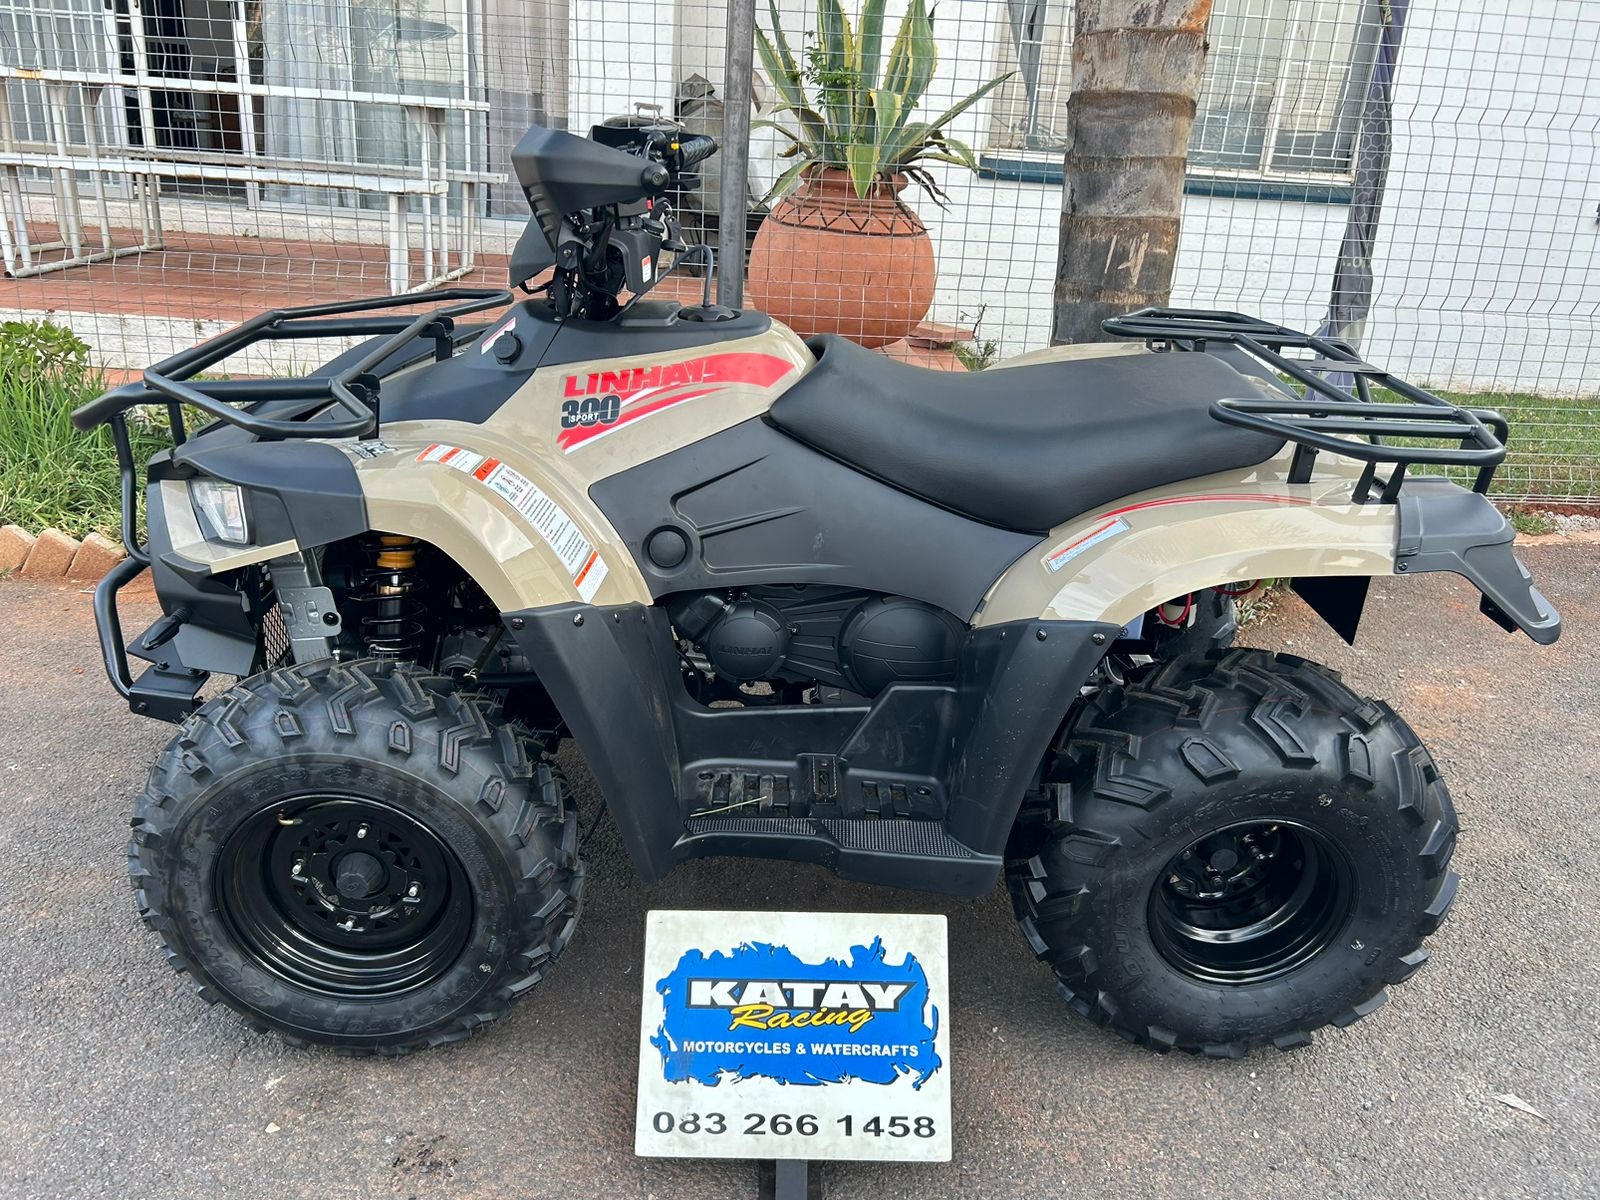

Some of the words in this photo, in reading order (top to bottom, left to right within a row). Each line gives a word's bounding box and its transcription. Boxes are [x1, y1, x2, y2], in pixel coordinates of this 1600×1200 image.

[561, 395, 621, 428] 300
[570, 413, 600, 423] SPORT
[689, 980, 909, 1010] KATAY
[730, 1003, 874, 1032] Racing
[682, 1040, 791, 1055] MOTORCYCLES
[795, 1043, 807, 1055] &
[810, 1043, 919, 1058] WATERCRAFTS
[653, 1111, 728, 1134] 083
[743, 1112, 819, 1136] 266
[836, 1114, 936, 1138] 1458
